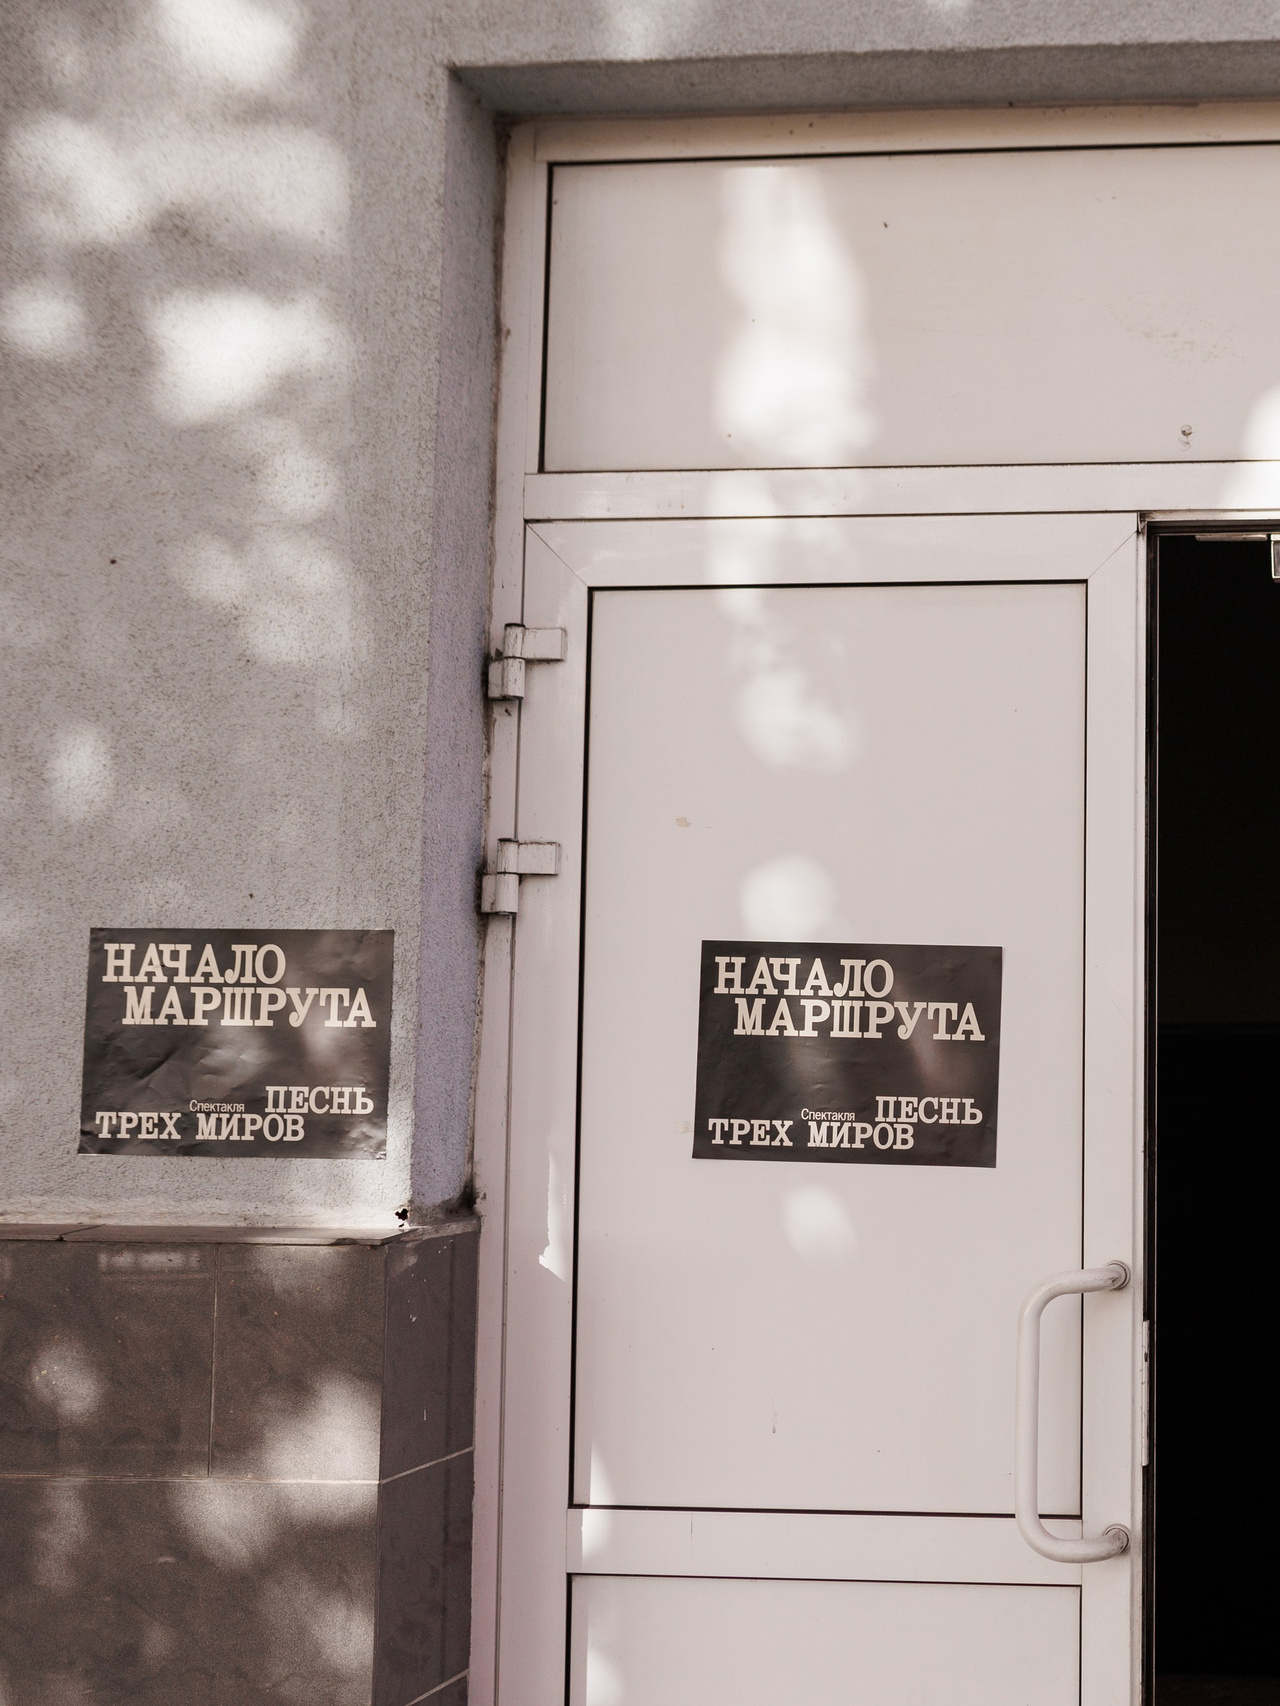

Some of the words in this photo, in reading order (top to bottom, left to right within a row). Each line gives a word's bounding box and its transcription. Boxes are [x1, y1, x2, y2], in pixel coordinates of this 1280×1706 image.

[101, 943, 286, 985] НАЧАЛО
[713, 956, 894, 998] НАЧАЛО
[121, 986, 377, 1028] МАРШРУТА
[733, 997, 985, 1041] МАРШРУТА
[189, 1099, 245, 1113] Спектакля
[265, 1085, 374, 1115] ПЕСНЬ
[801, 1108, 856, 1121] Спектакля
[874, 1095, 983, 1125] ПЕСНЬ
[95, 1112, 181, 1140] ТРЕХ
[195, 1113, 305, 1142] МИРОВ
[708, 1117, 793, 1147] ТРЕХ
[807, 1121, 915, 1150] МИРОВ
